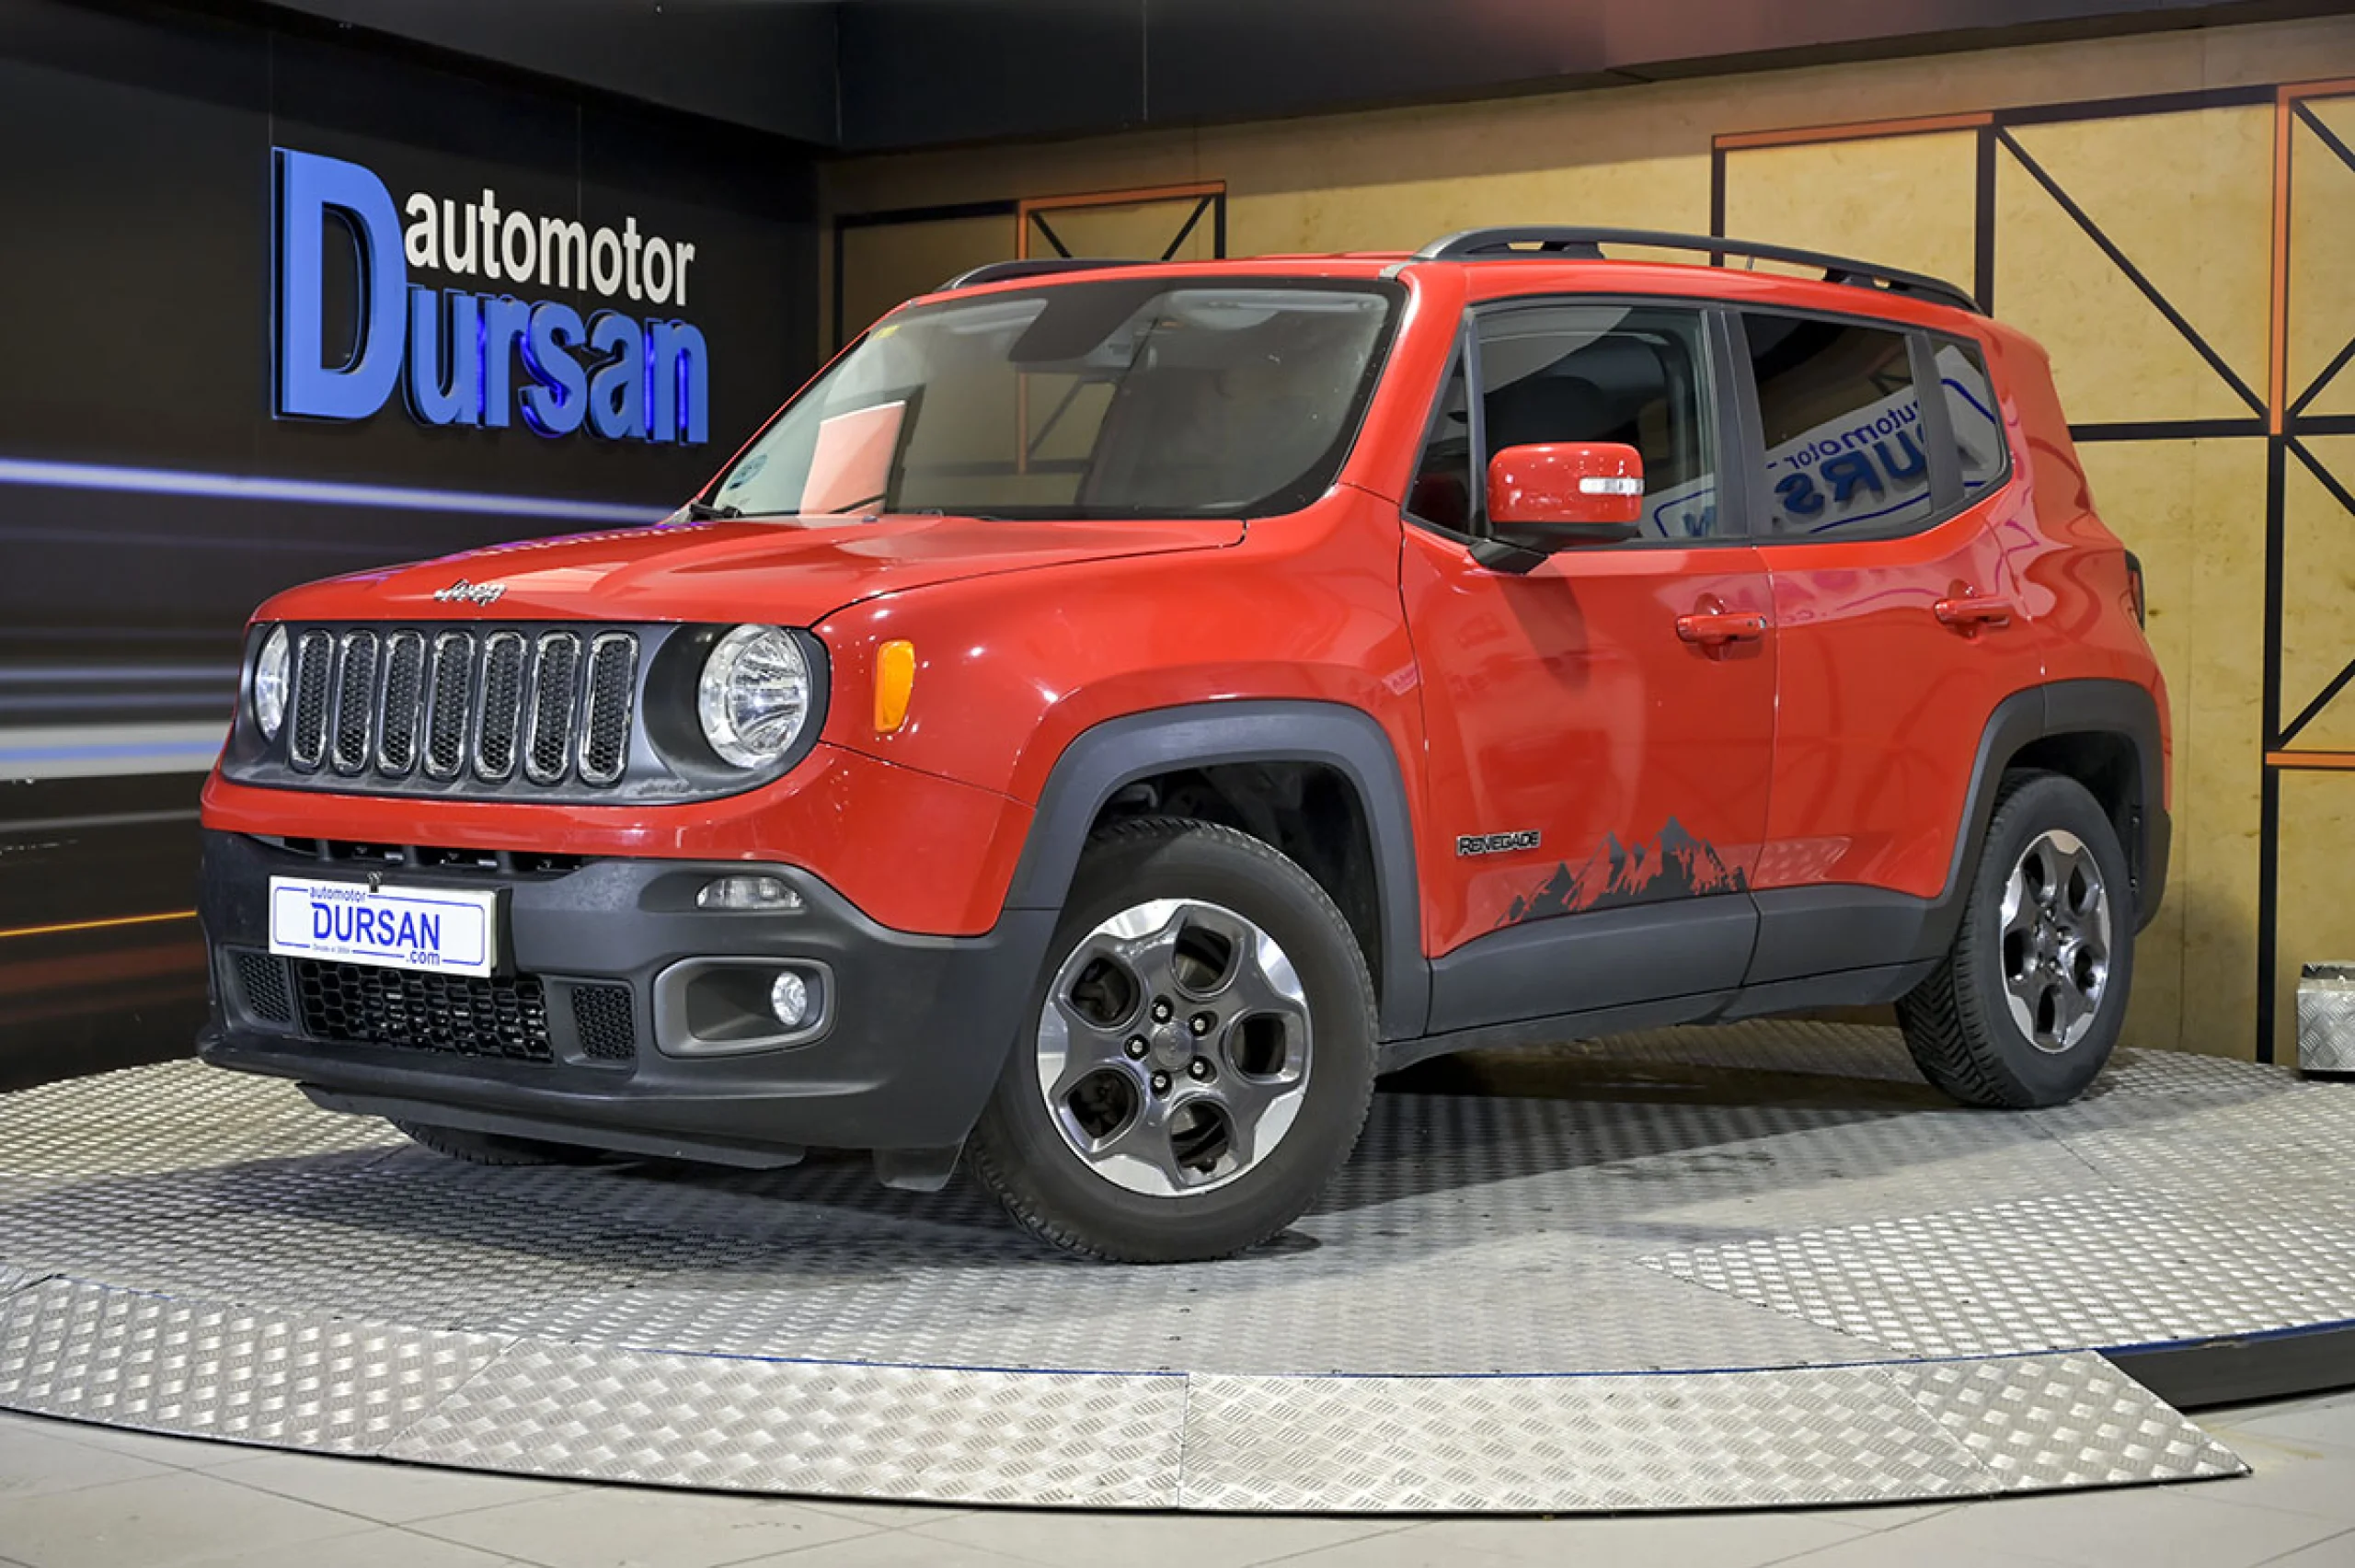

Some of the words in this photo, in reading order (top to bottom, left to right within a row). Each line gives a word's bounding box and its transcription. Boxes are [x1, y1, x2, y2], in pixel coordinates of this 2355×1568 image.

[405, 189, 695, 305] automotor
[272, 147, 708, 443] Dursan
[432, 578, 508, 606] Jeep
[1456, 829, 1541, 856] RENEGADE
[309, 886, 366, 903] automotor
[310, 901, 440, 950] DURSAN
[406, 950, 441, 966] .com
